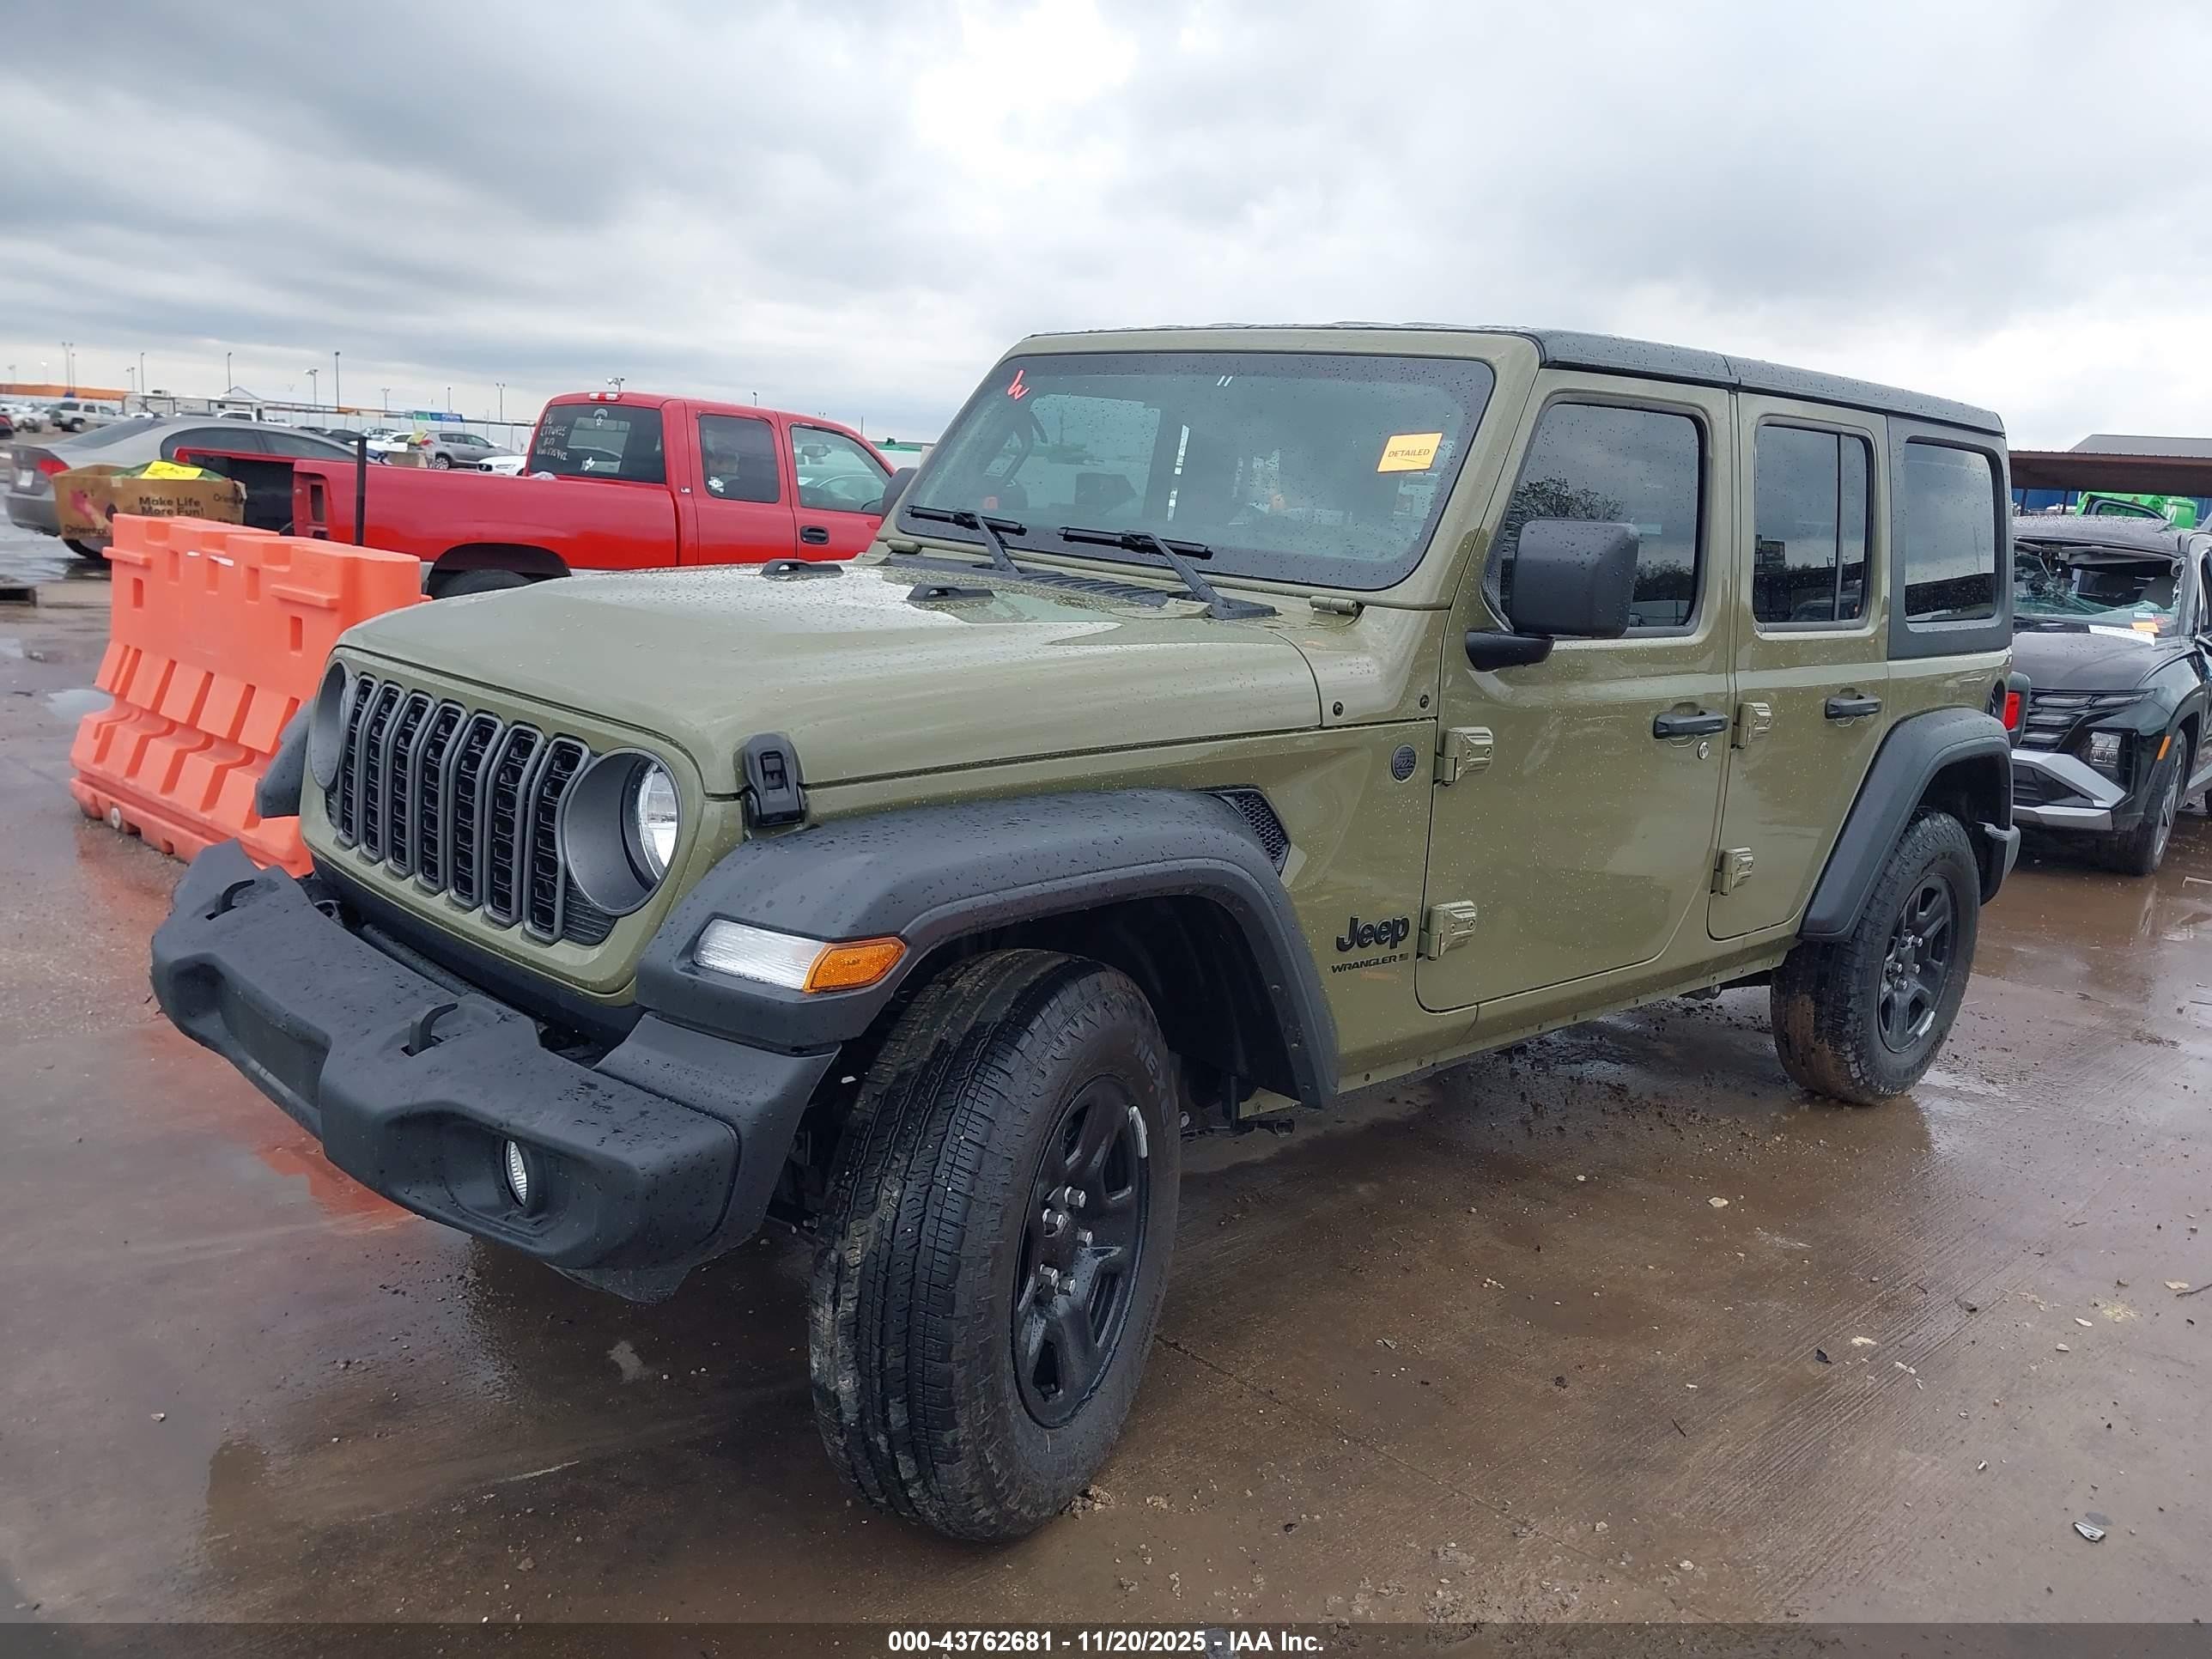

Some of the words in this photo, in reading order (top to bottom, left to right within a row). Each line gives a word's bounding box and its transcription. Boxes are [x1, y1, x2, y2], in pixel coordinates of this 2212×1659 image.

[1389, 448, 1430, 457] DETAILED
[139, 496, 173, 507] Make
[177, 497, 201, 507] Life
[141, 507, 173, 515] More
[1336, 915, 1410, 951] Jeep
[1331, 954, 1397, 974] WRANGLER
